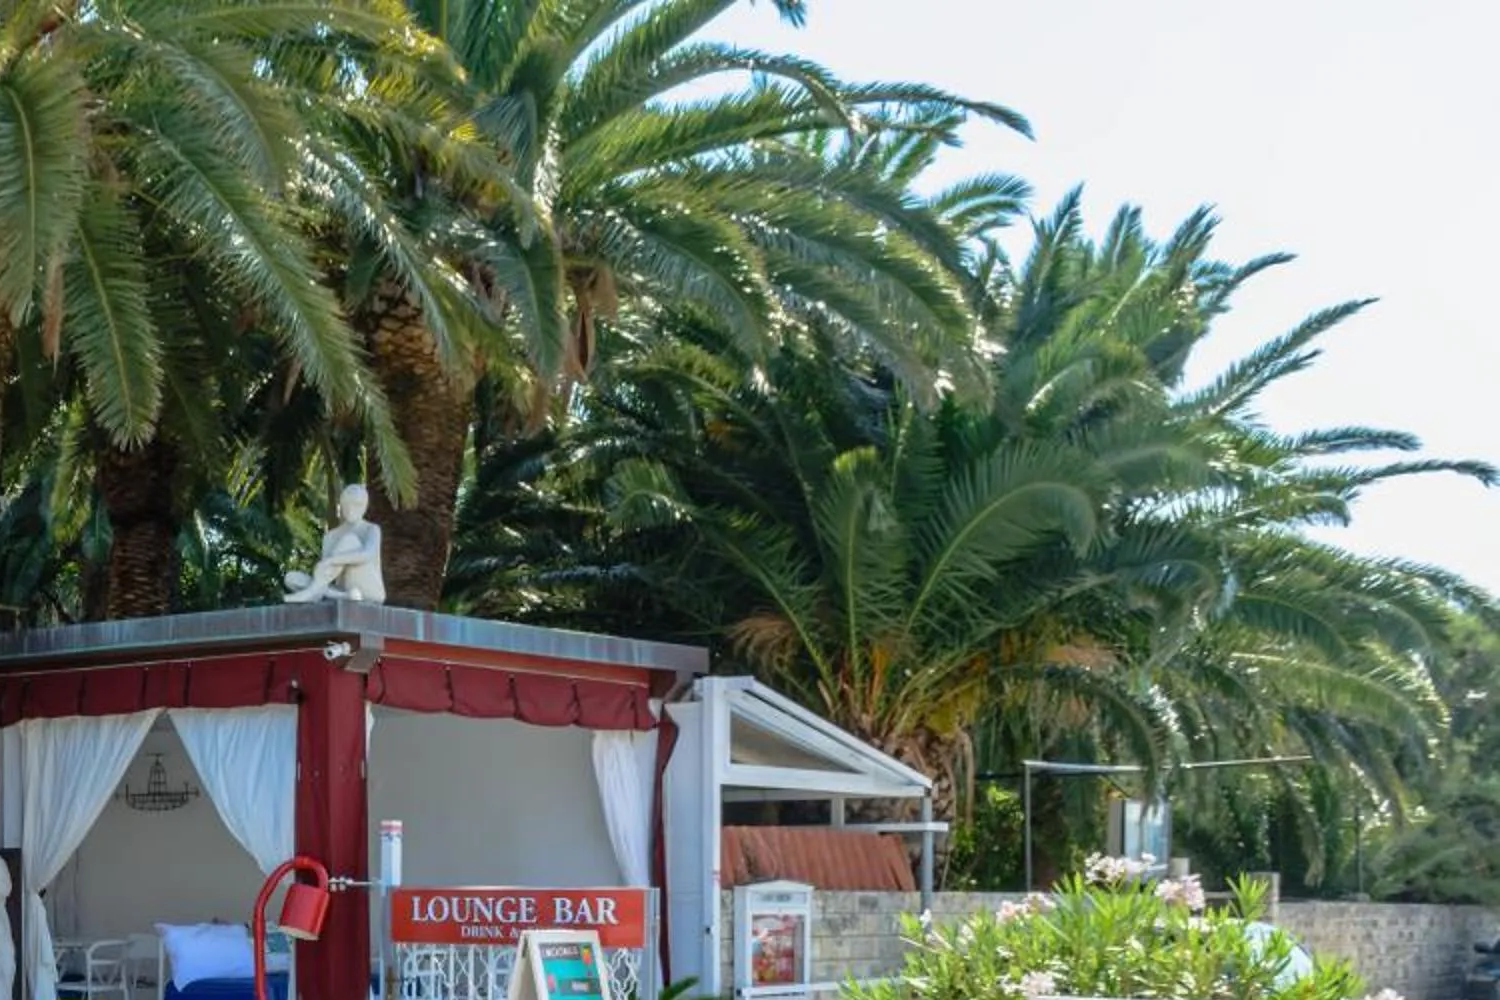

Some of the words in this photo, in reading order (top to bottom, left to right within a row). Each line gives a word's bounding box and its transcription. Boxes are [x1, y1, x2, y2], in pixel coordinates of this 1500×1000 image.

[411, 896, 537, 923] LOUNGE
[553, 896, 619, 924] BAR
[461, 926, 504, 938] DRINK
